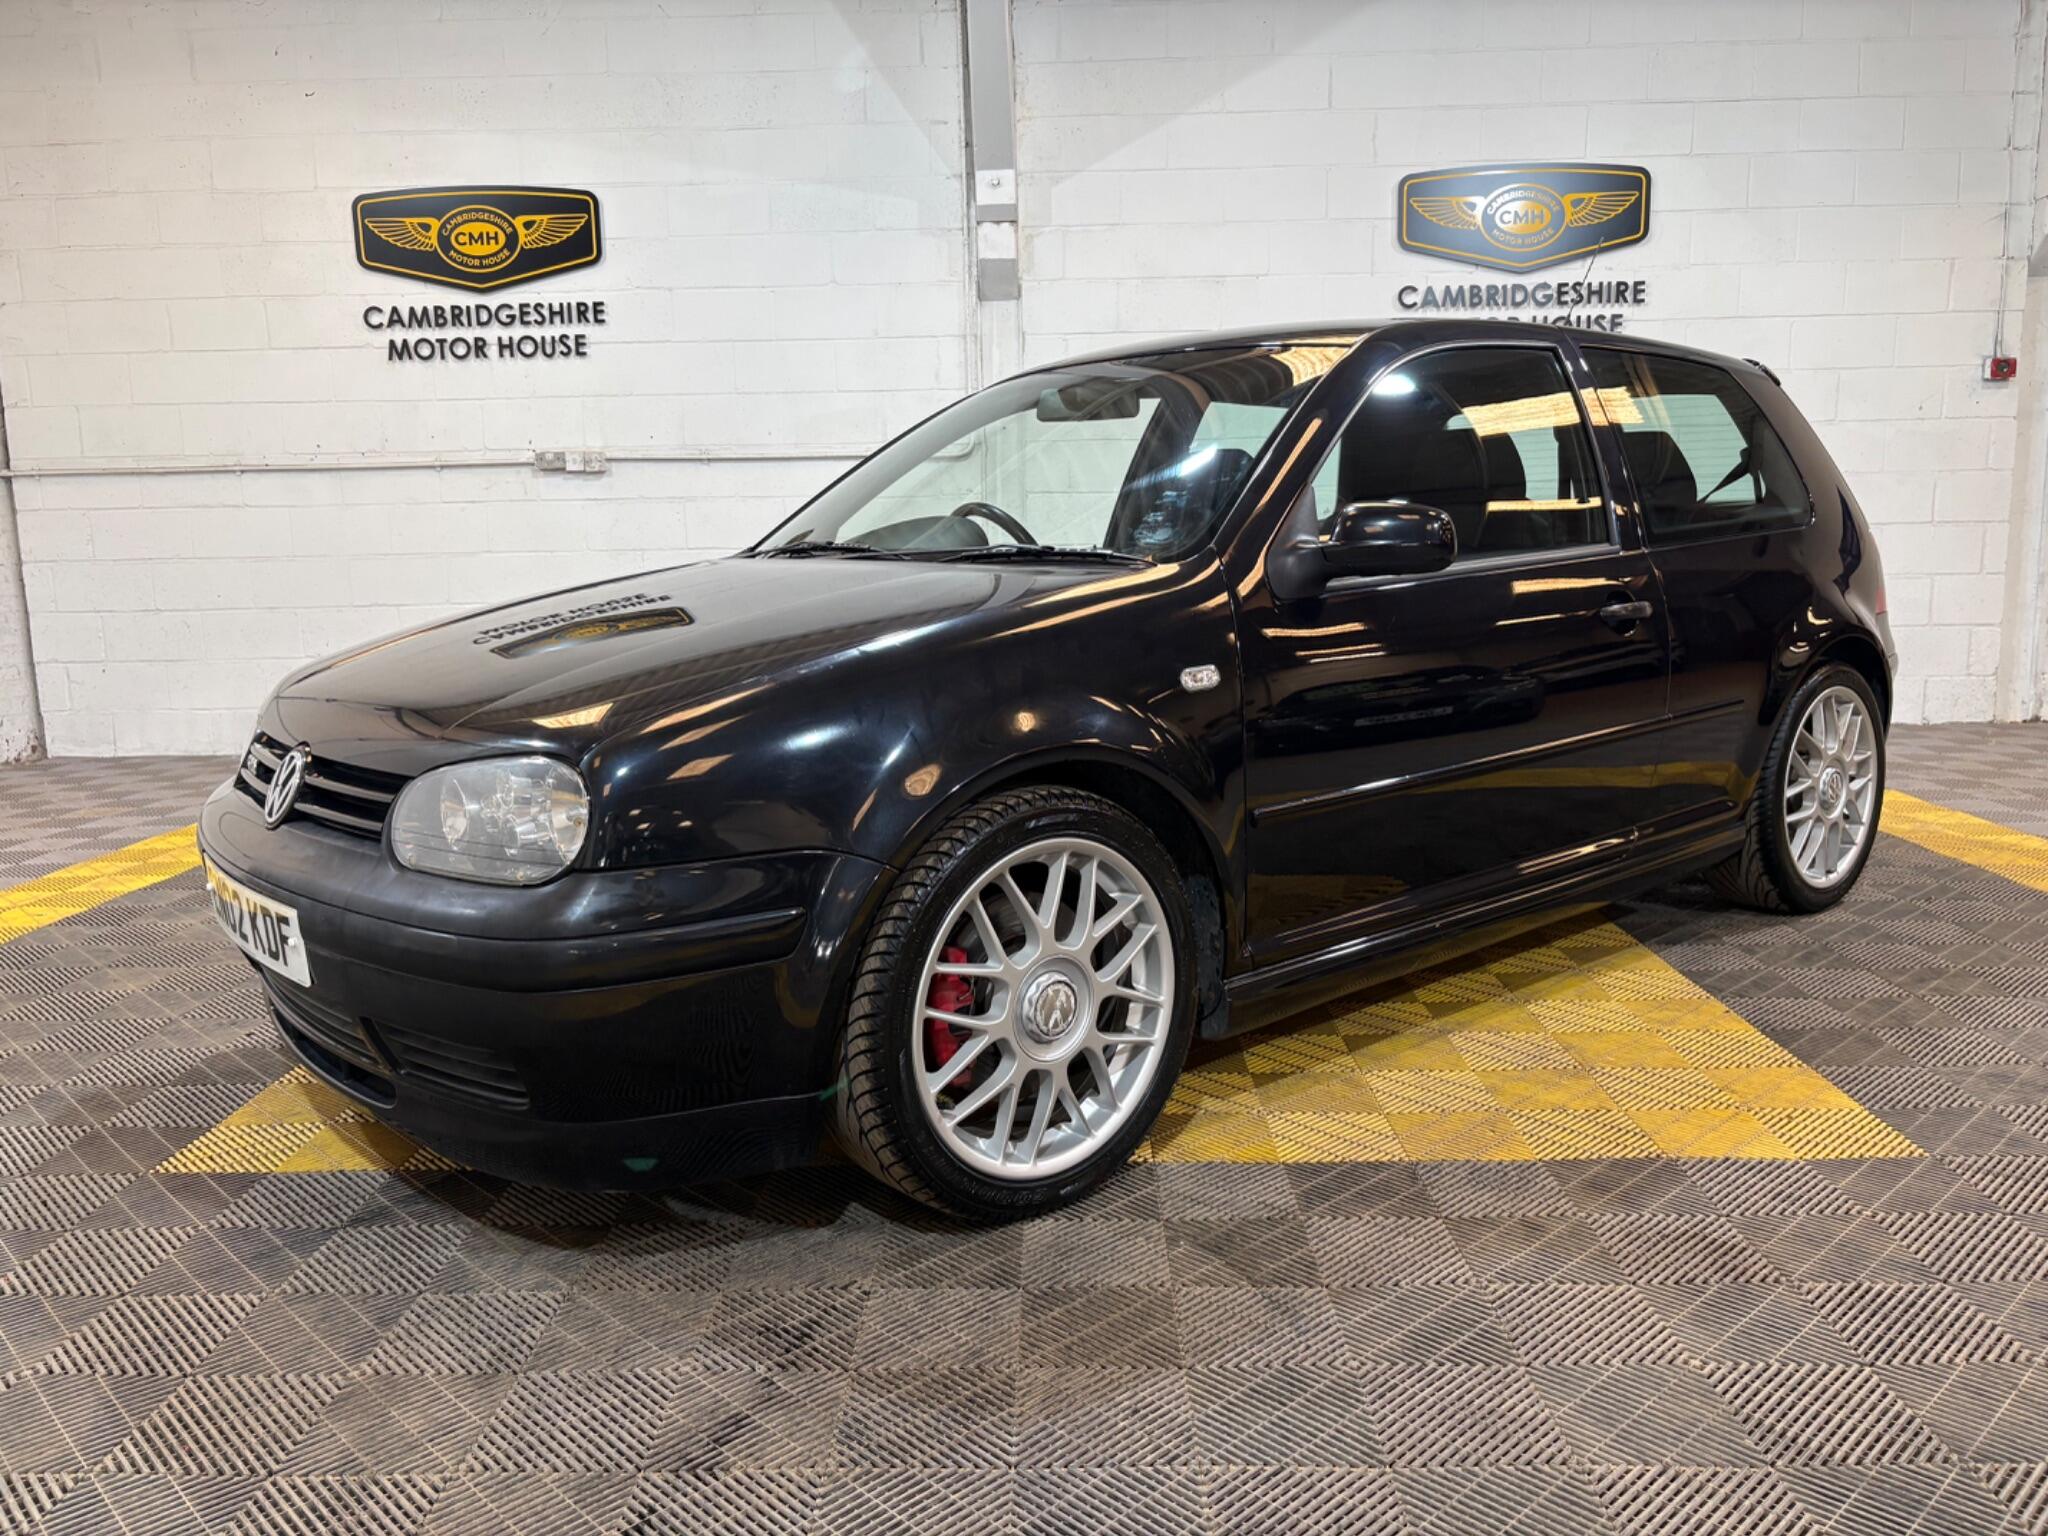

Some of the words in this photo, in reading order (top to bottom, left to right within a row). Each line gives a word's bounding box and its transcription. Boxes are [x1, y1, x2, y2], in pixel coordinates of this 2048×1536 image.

[442, 211, 513, 236] CAMBRIDGESHIRE
[1499, 210, 1545, 225] CMH
[454, 231, 499, 246] CMH
[448, 249, 480, 267] MOTOR
[482, 247, 511, 267] HOUSE
[1398, 280, 1647, 310] CAMBRIDGESHIRE
[363, 301, 607, 330] CAMBRIDGESHIRE
[388, 336, 488, 361] MOTOR
[498, 334, 589, 359] HOUSE
[245, 897, 291, 967] KDF
